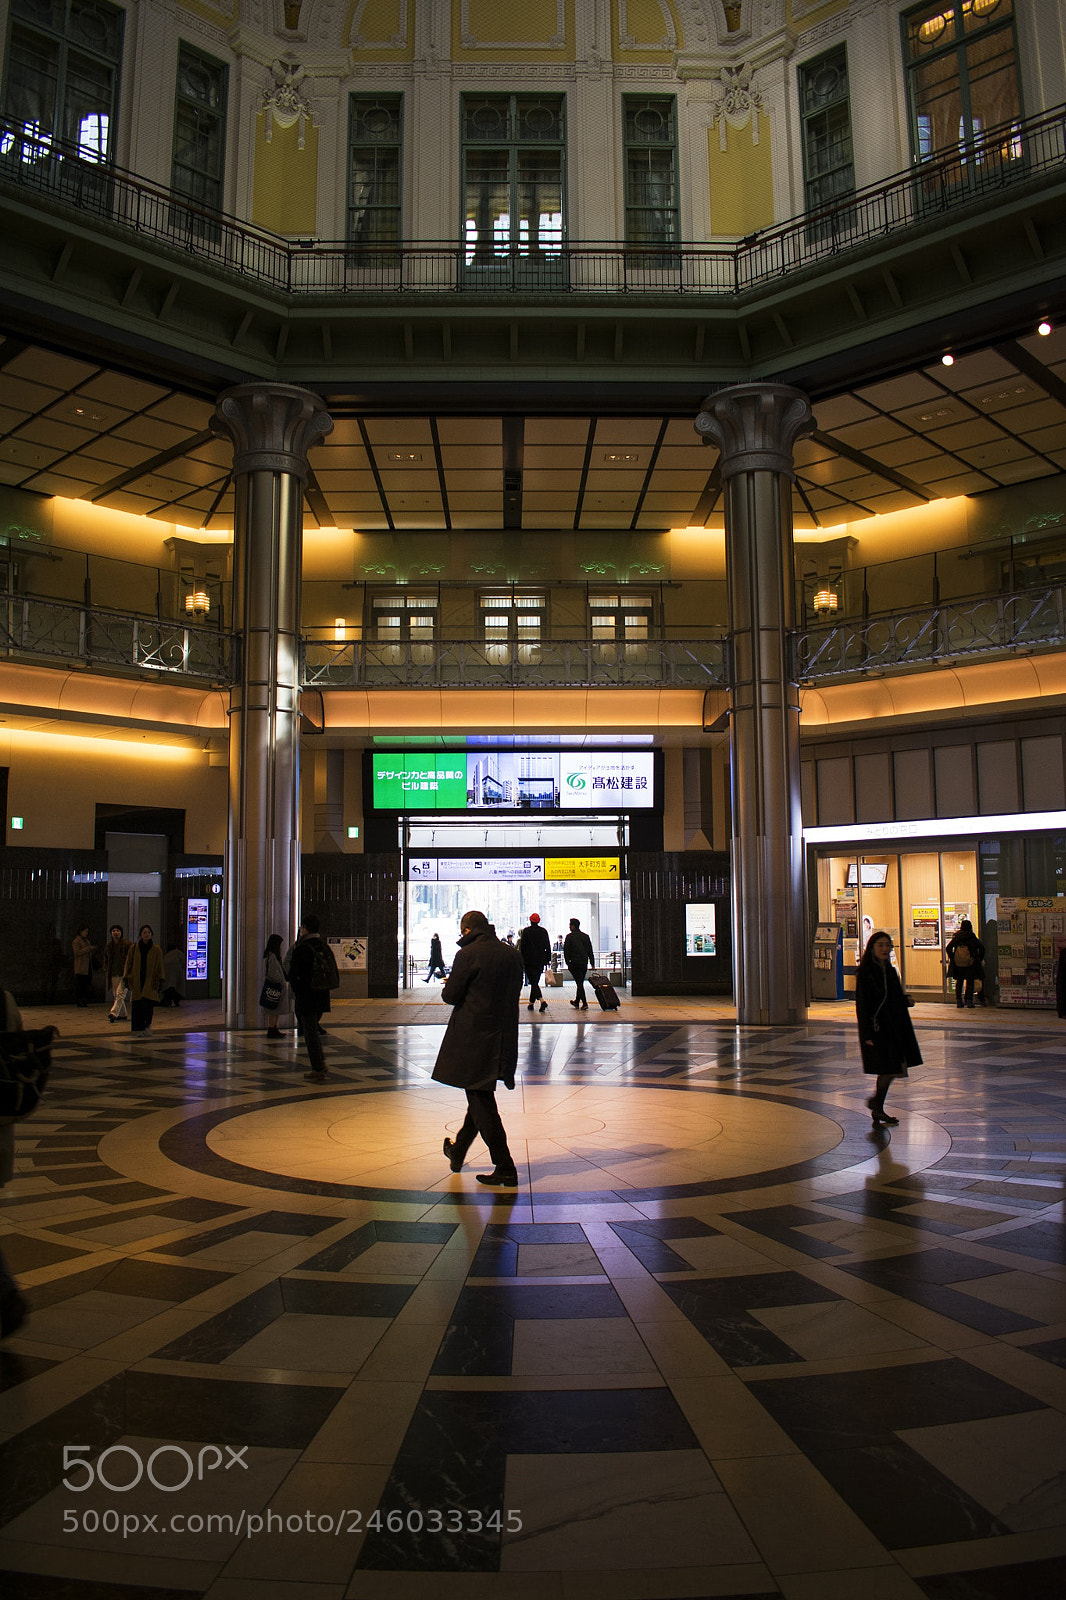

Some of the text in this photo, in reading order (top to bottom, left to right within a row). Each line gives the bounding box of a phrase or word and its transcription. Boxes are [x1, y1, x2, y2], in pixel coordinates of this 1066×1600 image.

[377, 770, 463, 780] デザイン力と高品質の
[401, 781, 439, 791] ビル建築
